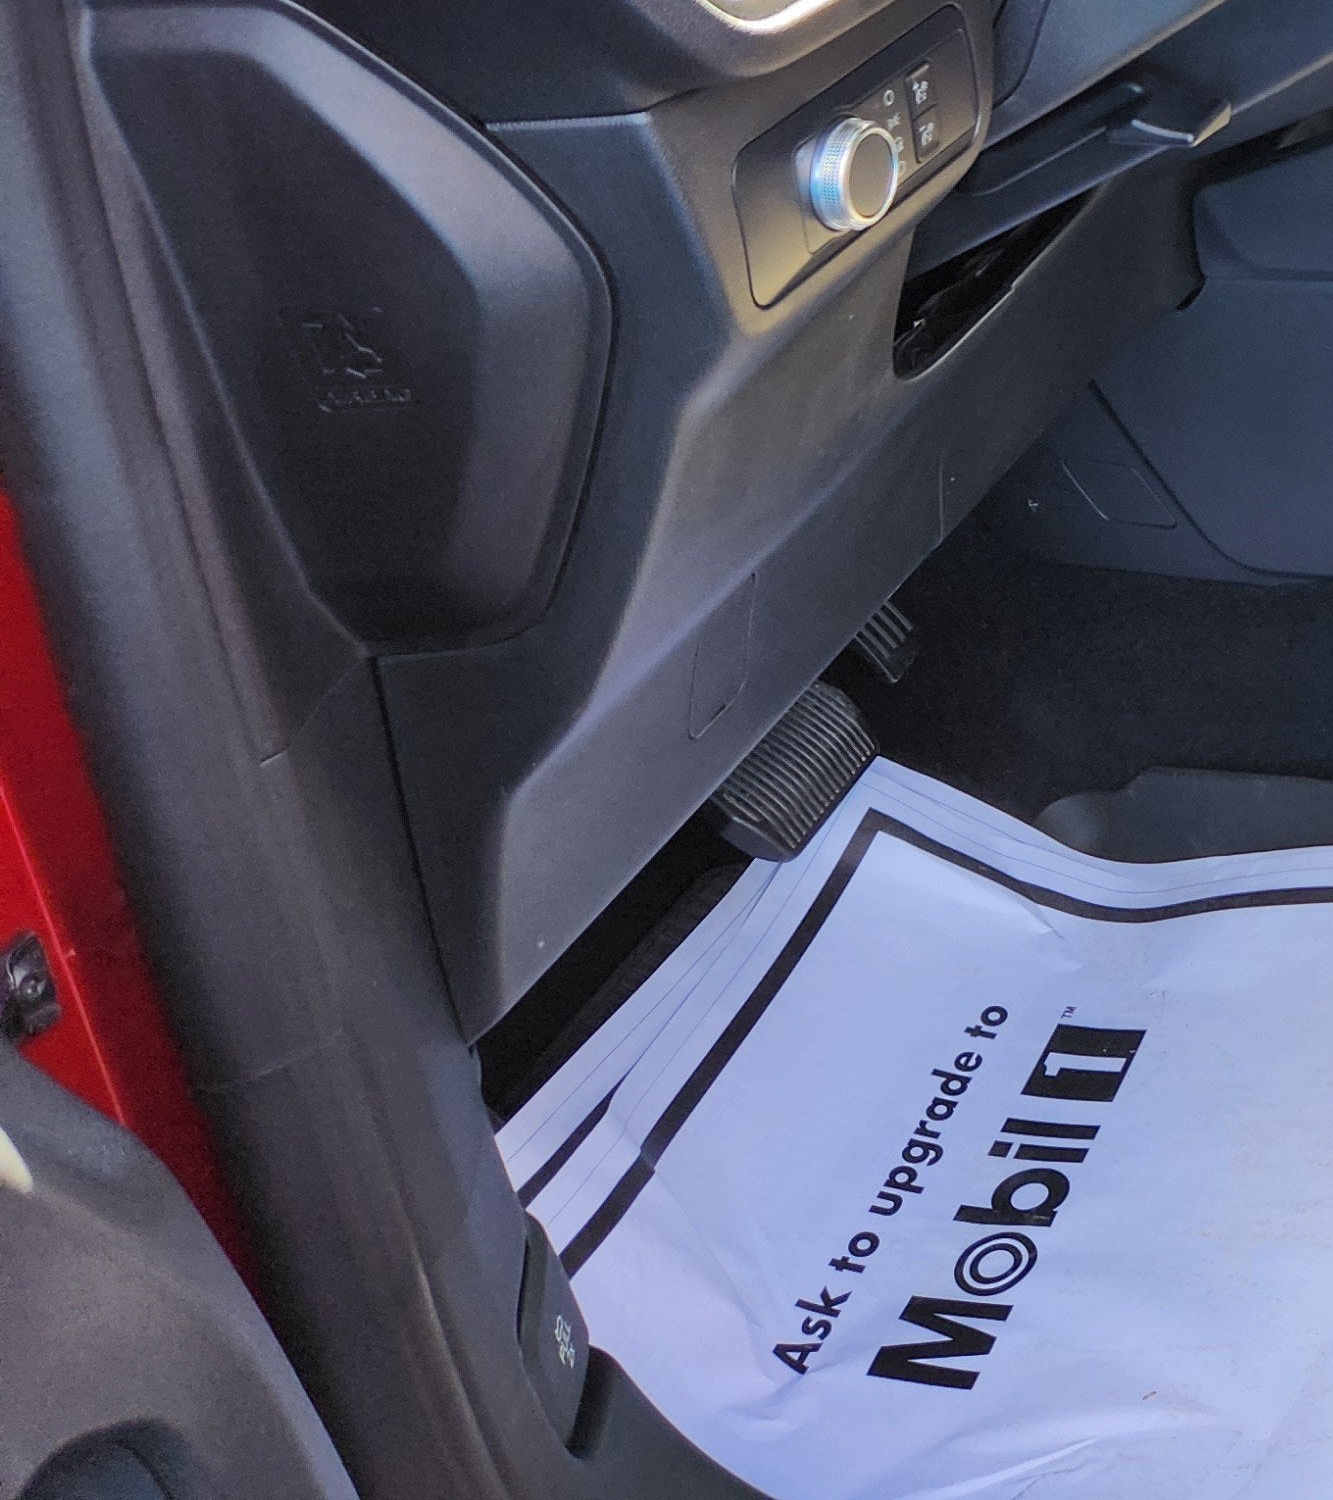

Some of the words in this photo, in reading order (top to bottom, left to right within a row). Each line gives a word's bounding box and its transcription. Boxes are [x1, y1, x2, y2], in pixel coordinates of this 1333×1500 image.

[771, 1286, 853, 1376] Ask
[829, 1231, 880, 1275] to
[868, 1052, 983, 1217] upgrade
[963, 1005, 1009, 1041] to
[865, 1117, 1102, 1391] Mobil
